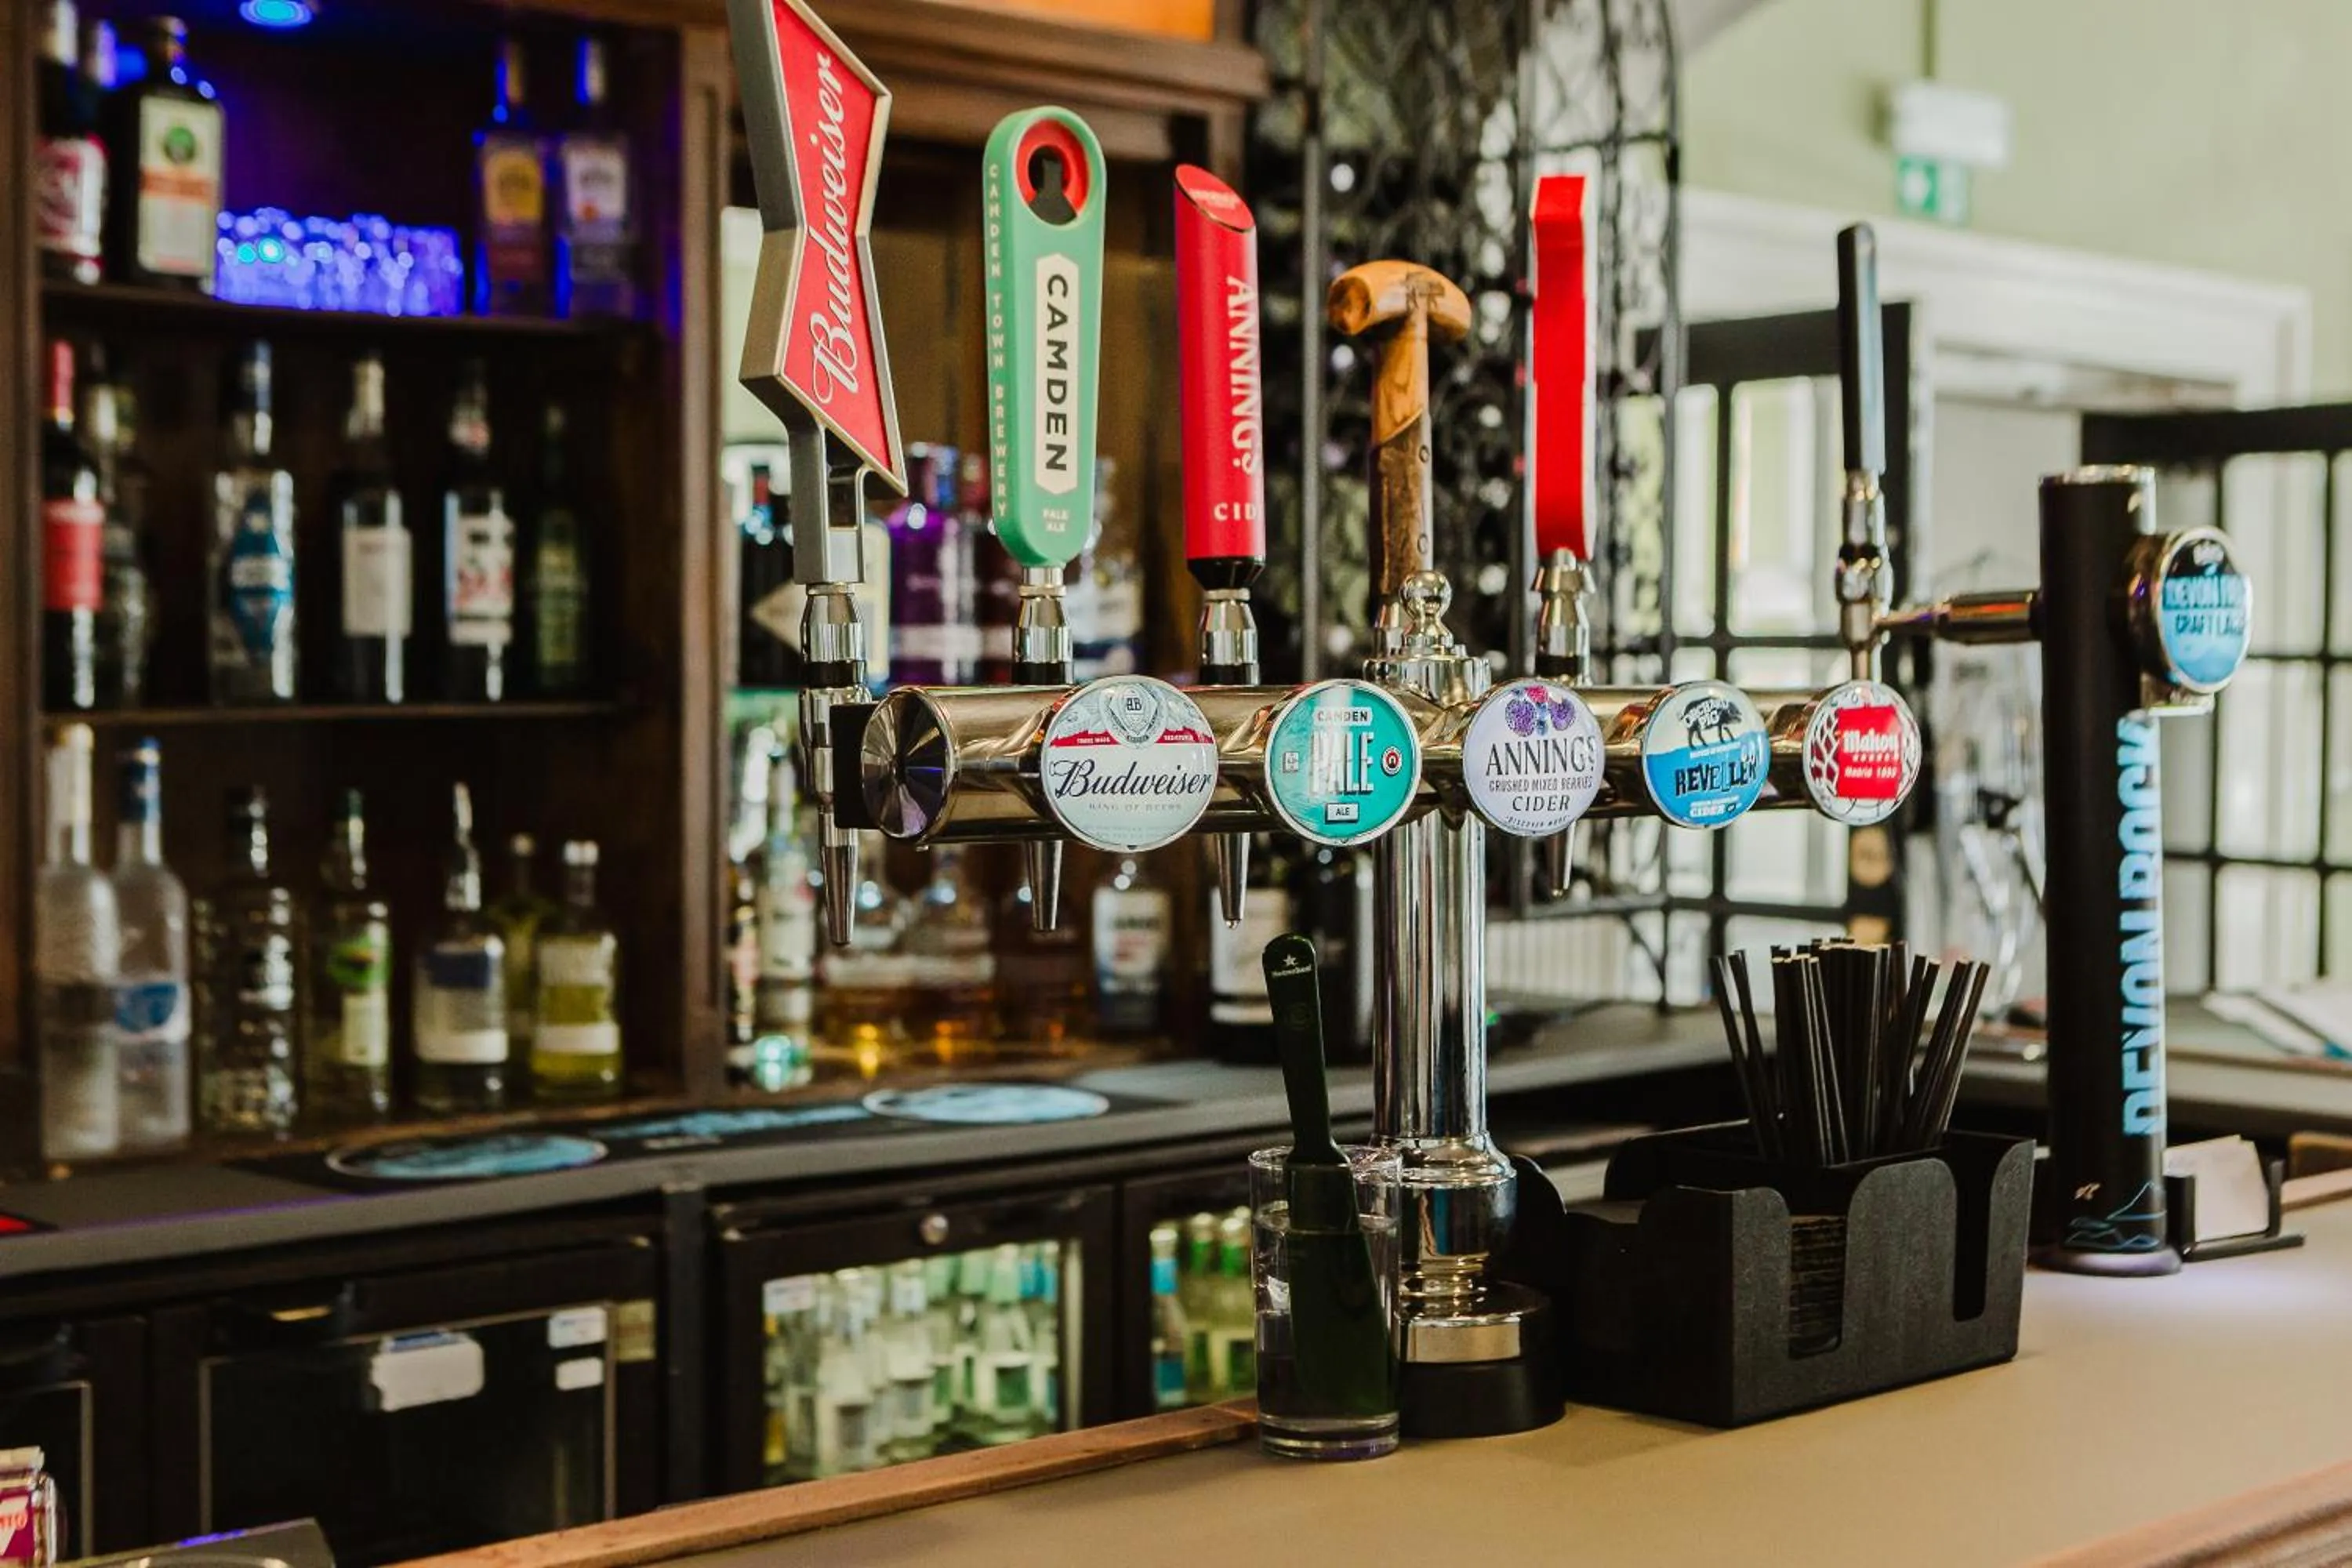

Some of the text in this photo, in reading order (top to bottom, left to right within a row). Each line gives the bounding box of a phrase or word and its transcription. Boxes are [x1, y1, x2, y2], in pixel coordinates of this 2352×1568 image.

[808, 51, 861, 405] Budweiser
[989, 164, 1007, 517] CAMDEN TOWN BREWERY
[1045, 274, 1069, 471] CAMDEN
[1049, 758, 1212, 800] Budweiser
[1335, 807, 1350, 817] ALE
[1490, 779, 1529, 793] CRUSHED
[1531, 779, 1558, 792] MIXED
[1512, 795, 1571, 812] CIDER
[2119, 909, 2166, 1135] DEVON
